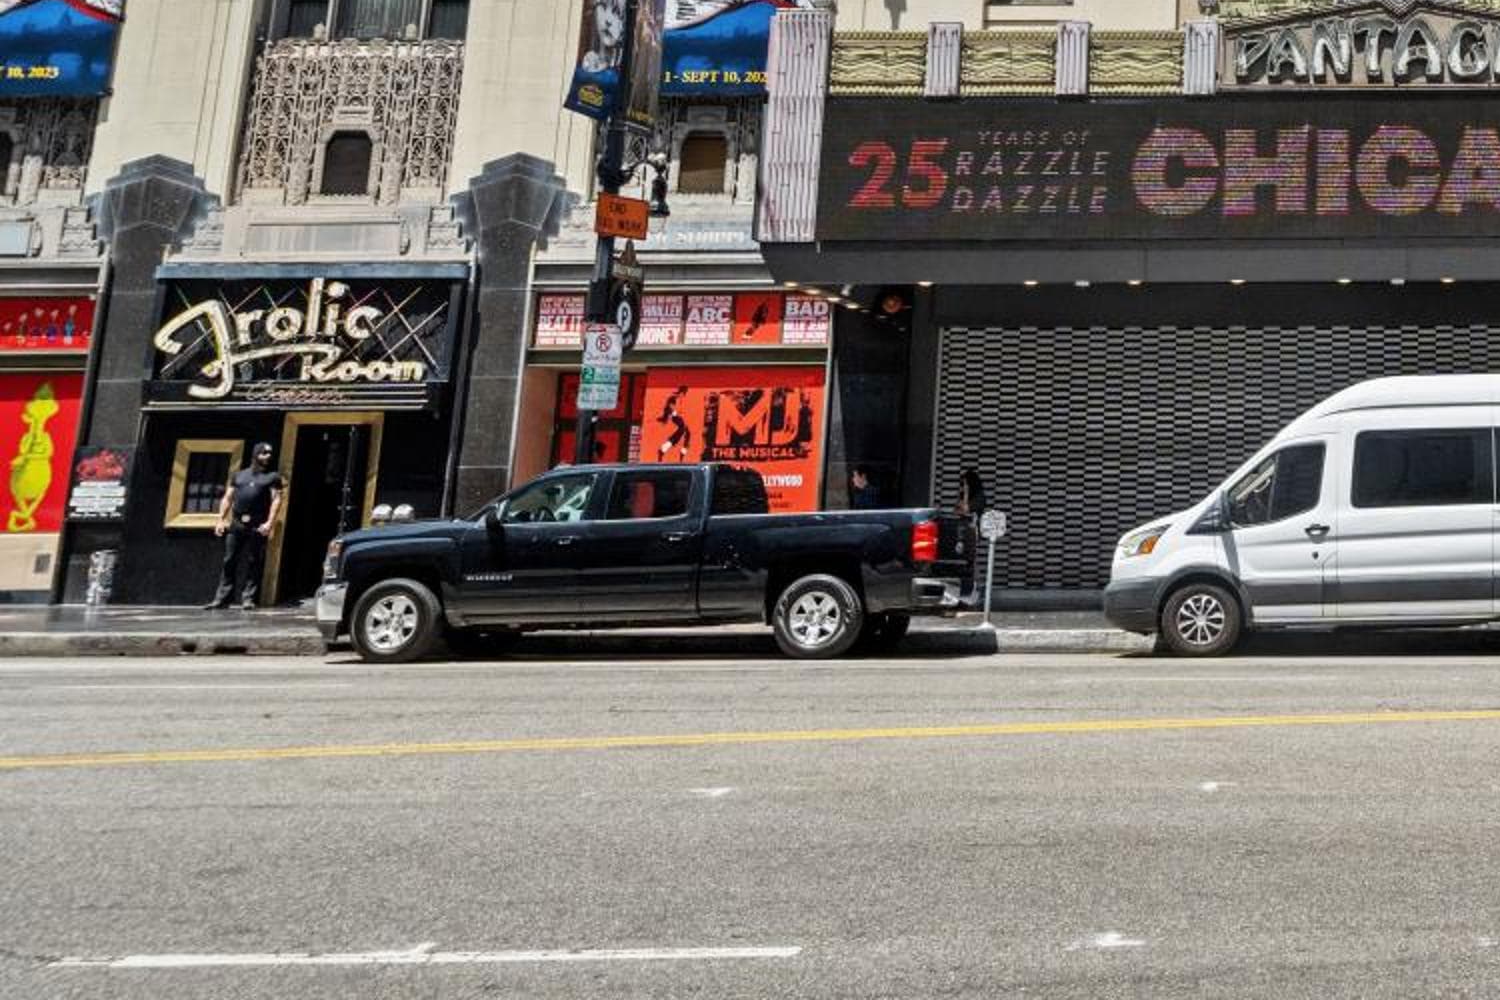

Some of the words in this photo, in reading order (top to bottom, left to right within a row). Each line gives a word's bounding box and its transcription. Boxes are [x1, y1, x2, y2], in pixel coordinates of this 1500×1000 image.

[682, 71, 720, 83] SEPT
[724, 71, 741, 85] 10,
[977, 130, 1050, 145] YEARS
[1062, 130, 1091, 145] OF
[848, 137, 949, 208] 25
[955, 151, 1110, 175] RAZZLE
[951, 185, 1108, 213] DAZZLE
[687, 307, 731, 323] ABC
[785, 301, 829, 316] BAD
[153, 277, 385, 398] Frolic
[636, 327, 681, 344] MONEY
[301, 347, 427, 381] Room
[714, 387, 801, 445] MJ
[713, 447, 737, 458] THE
[740, 447, 796, 458] MUSICAL
